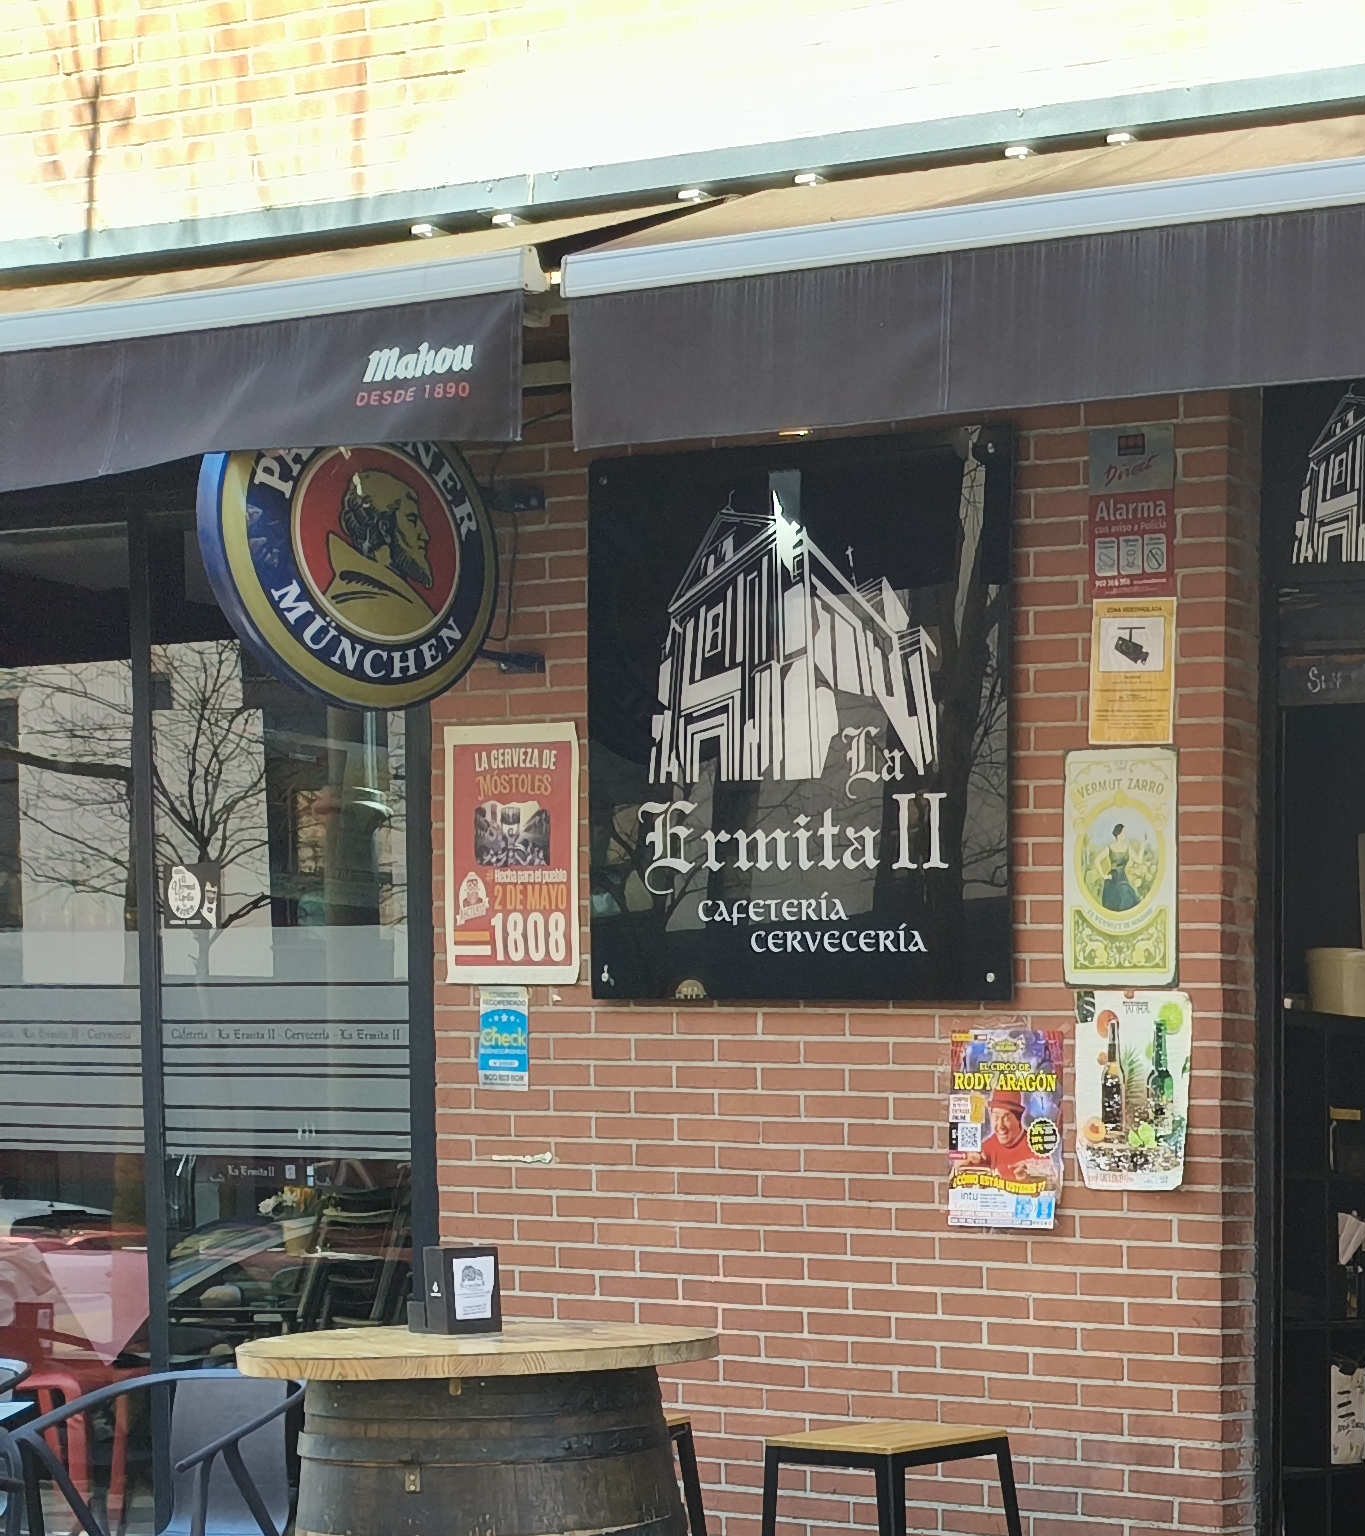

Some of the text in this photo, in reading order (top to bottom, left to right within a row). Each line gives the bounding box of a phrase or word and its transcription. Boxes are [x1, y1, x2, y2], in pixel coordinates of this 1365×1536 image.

[363, 341, 474, 384] Mahou
[355, 381, 471, 407] DESDE 1890
[1095, 499, 1166, 521] Alarma
[270, 578, 464, 679] MÜNCHEN
[475, 748, 557, 772] LA CERVEZA DE
[842, 726, 905, 798] La
[476, 770, 552, 800] MÓSTOLES
[1077, 778, 1164, 799] VERMUT ZARRO
[638, 793, 950, 894] Ermita II
[494, 884, 567, 909] 2 DE MAYO
[697, 892, 846, 927] CAFETERÍA
[491, 911, 566, 962] 1808
[750, 923, 928, 953] CERVECERÍA
[481, 1027, 526, 1046] Check
[991, 1062, 1016, 1070] CIRCO
[954, 1070, 1057, 1092] RODY ARAGÓN
[961, 1192, 978, 1200] intu
